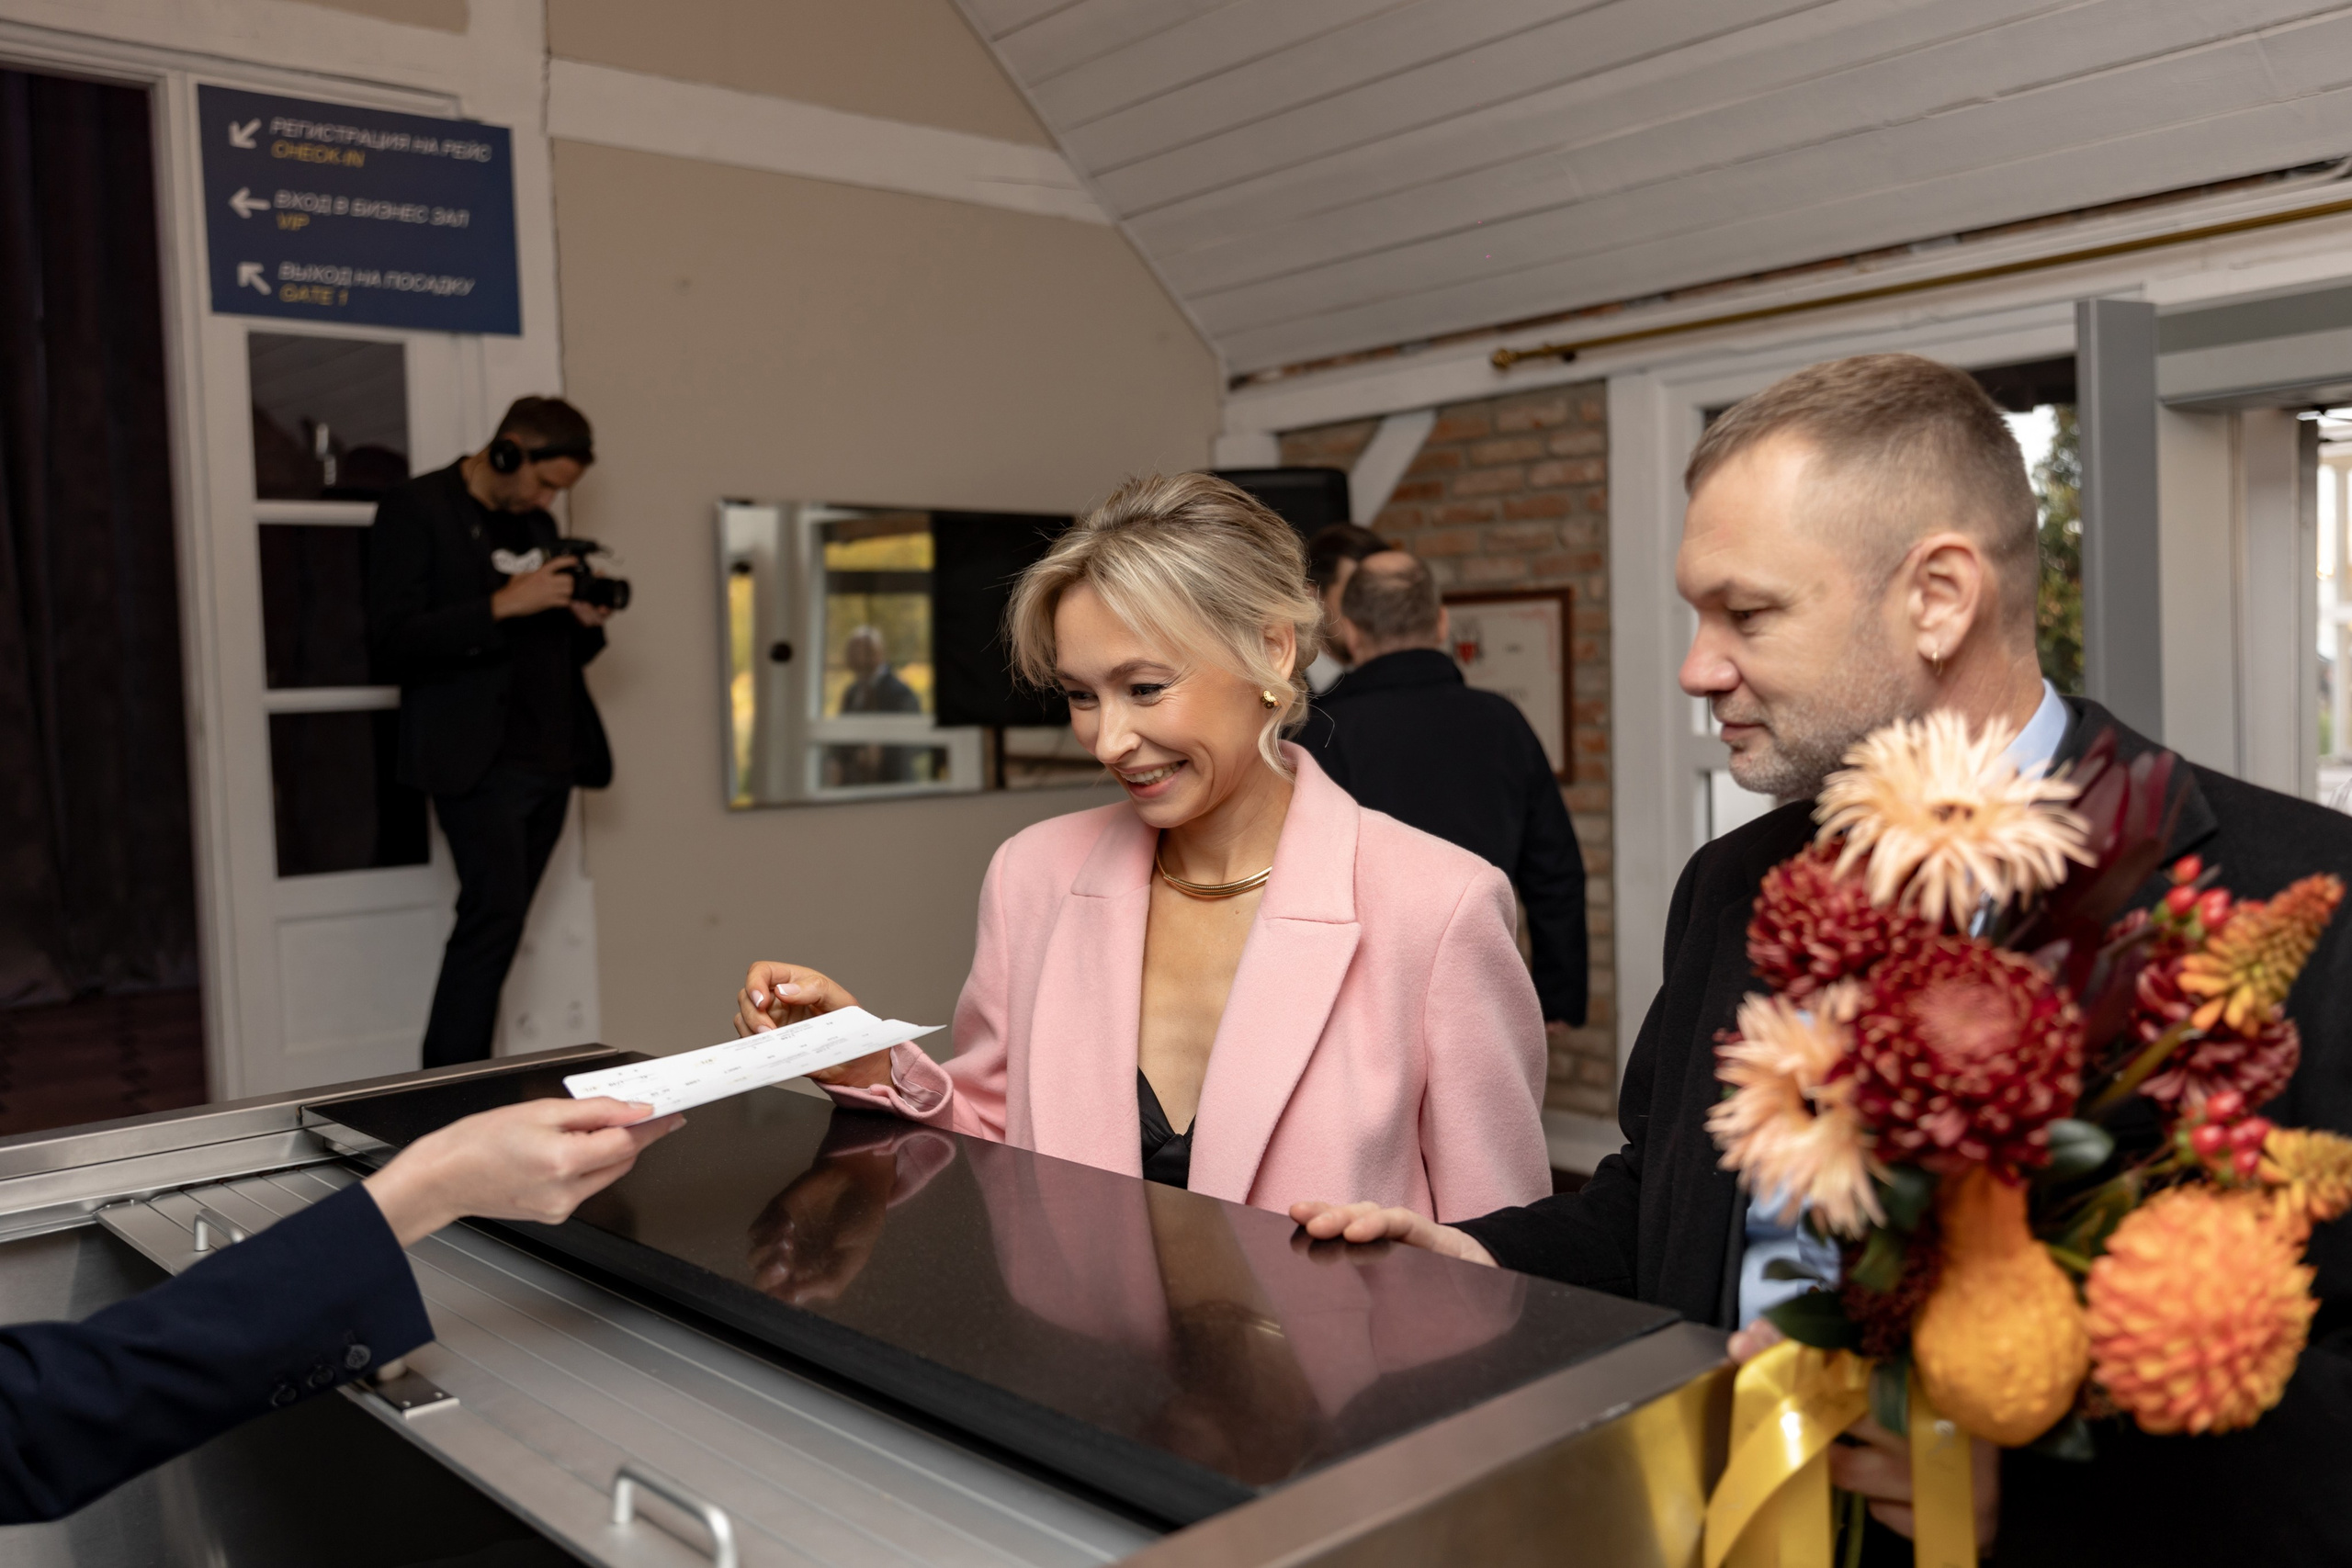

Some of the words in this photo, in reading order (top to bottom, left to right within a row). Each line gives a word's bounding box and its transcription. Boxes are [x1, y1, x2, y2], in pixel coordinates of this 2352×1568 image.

[270, 118, 411, 152] РЕГИСТРАЦИЯ
[413, 134, 439, 153] НА
[440, 140, 492, 163] РЕЙС
[274, 190, 332, 216] ВХОД
[334, 196, 349, 215] В
[350, 198, 429, 224] БИЗНЕС
[430, 208, 469, 229] ЗАЛ
[277, 212, 310, 231] VIP
[278, 262, 352, 287] ВЫХОД
[353, 269, 381, 288] НА
[384, 272, 475, 296] ПОСАДКУ
[279, 284, 333, 306] GATE
